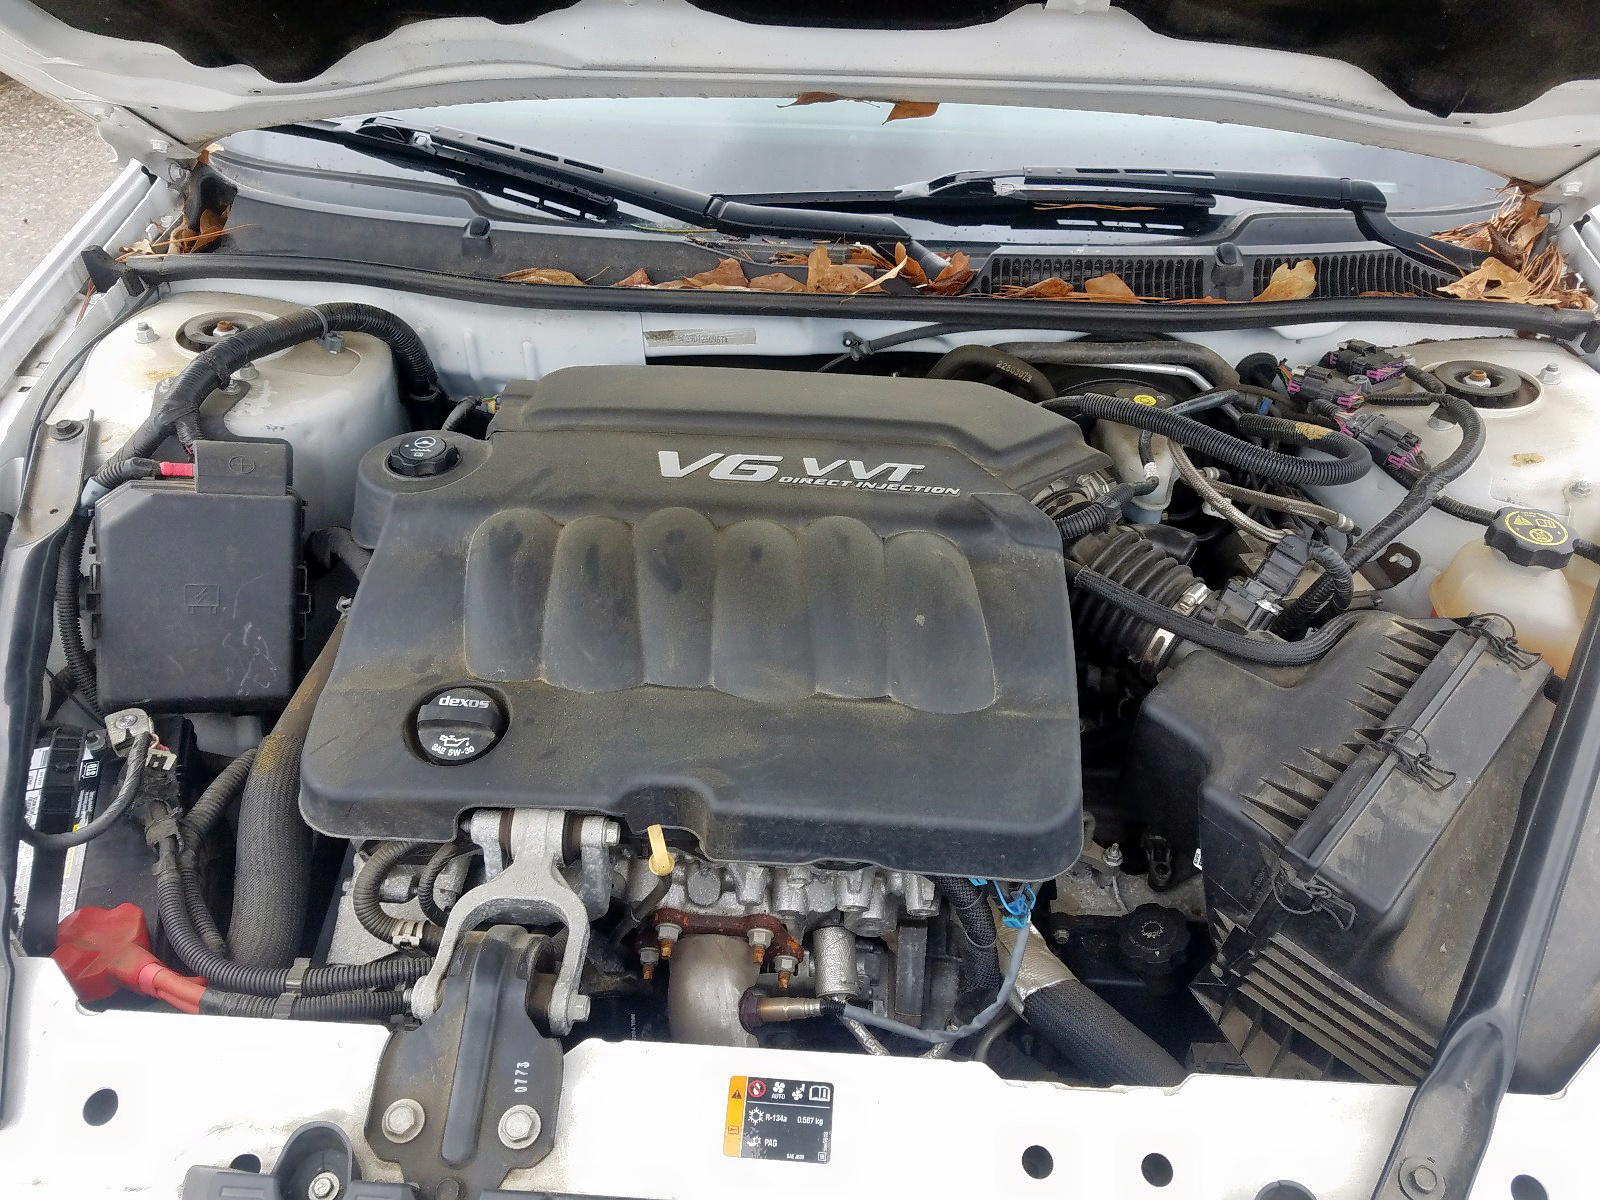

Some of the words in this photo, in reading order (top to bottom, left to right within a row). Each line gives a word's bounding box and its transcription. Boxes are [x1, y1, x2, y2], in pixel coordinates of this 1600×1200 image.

[657, 450, 784, 482] V6
[802, 456, 926, 483] VVT
[778, 475, 854, 489] DIRECT
[855, 480, 961, 496] INJECTION
[438, 695, 492, 709] dexos
[431, 743, 447, 755] SAE
[447, 745, 475, 757] 5W-30
[513, 1061, 530, 1093] 0773
[771, 1092, 786, 1101] AUTO
[765, 1113, 788, 1123] R-134a
[815, 1117, 824, 1127] kg
[764, 1137, 778, 1148] PAG
